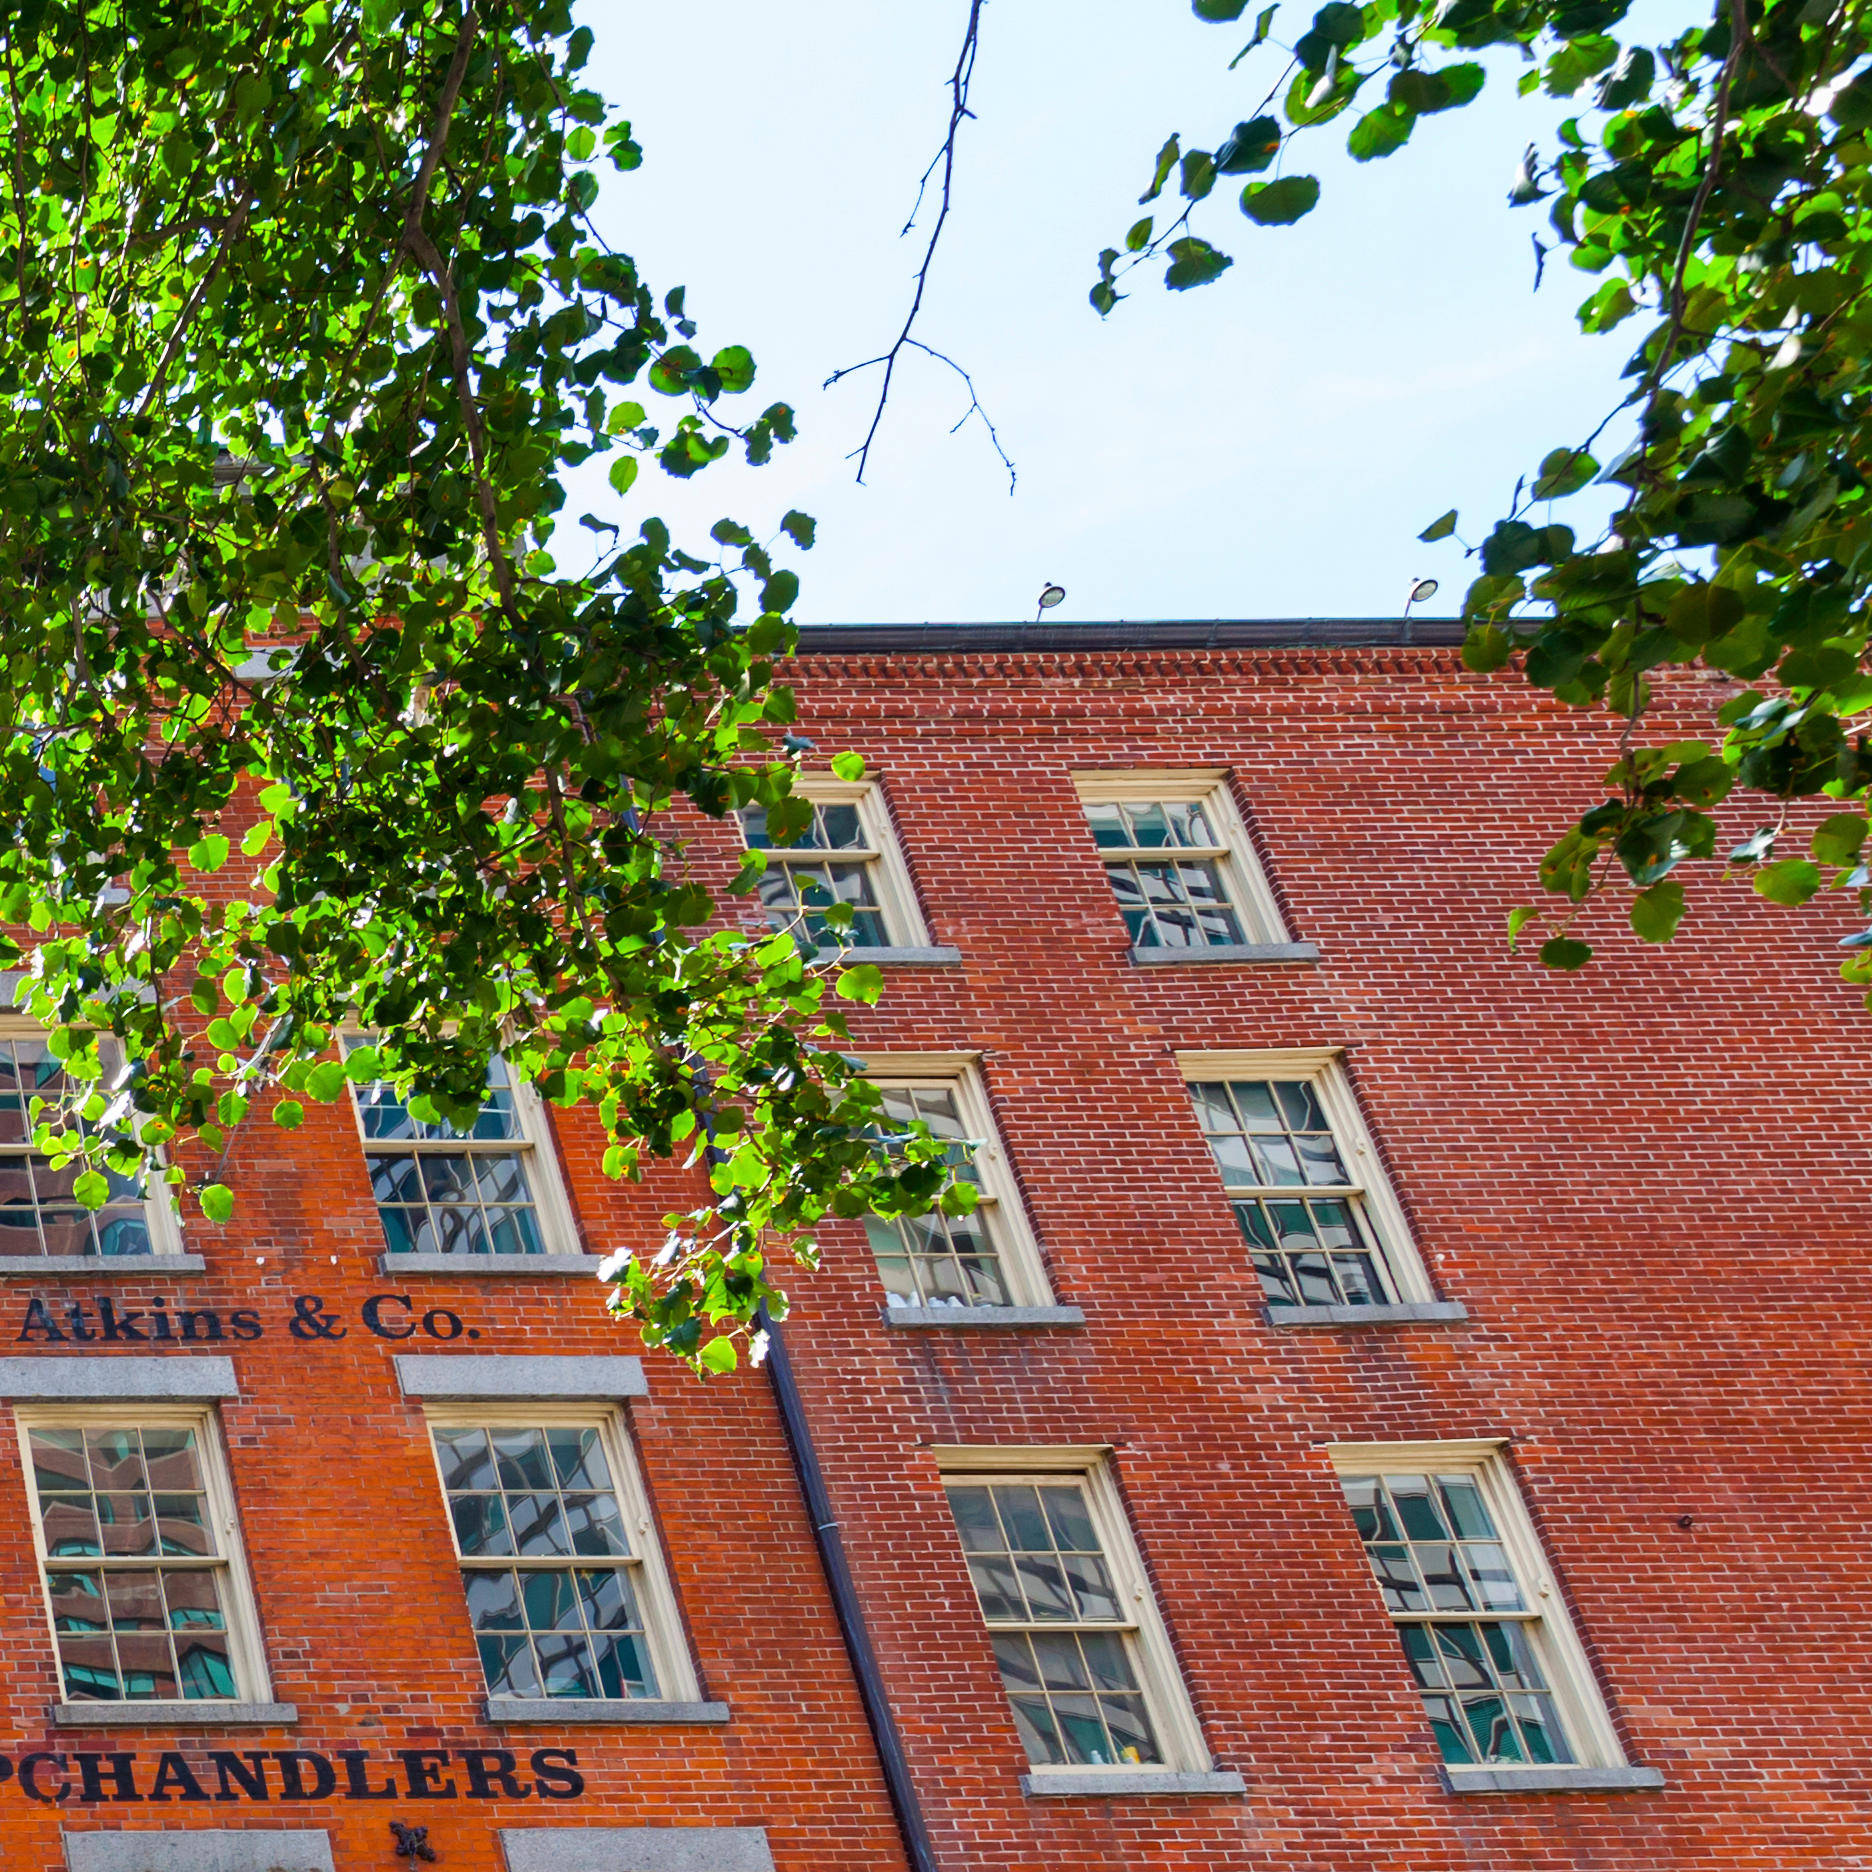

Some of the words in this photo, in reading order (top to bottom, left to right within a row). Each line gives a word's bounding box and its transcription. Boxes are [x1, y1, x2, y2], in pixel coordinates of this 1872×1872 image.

[15, 1297, 264, 1342] Atkins
[289, 1295, 347, 1340] &
[362, 1294, 480, 1340] Co.
